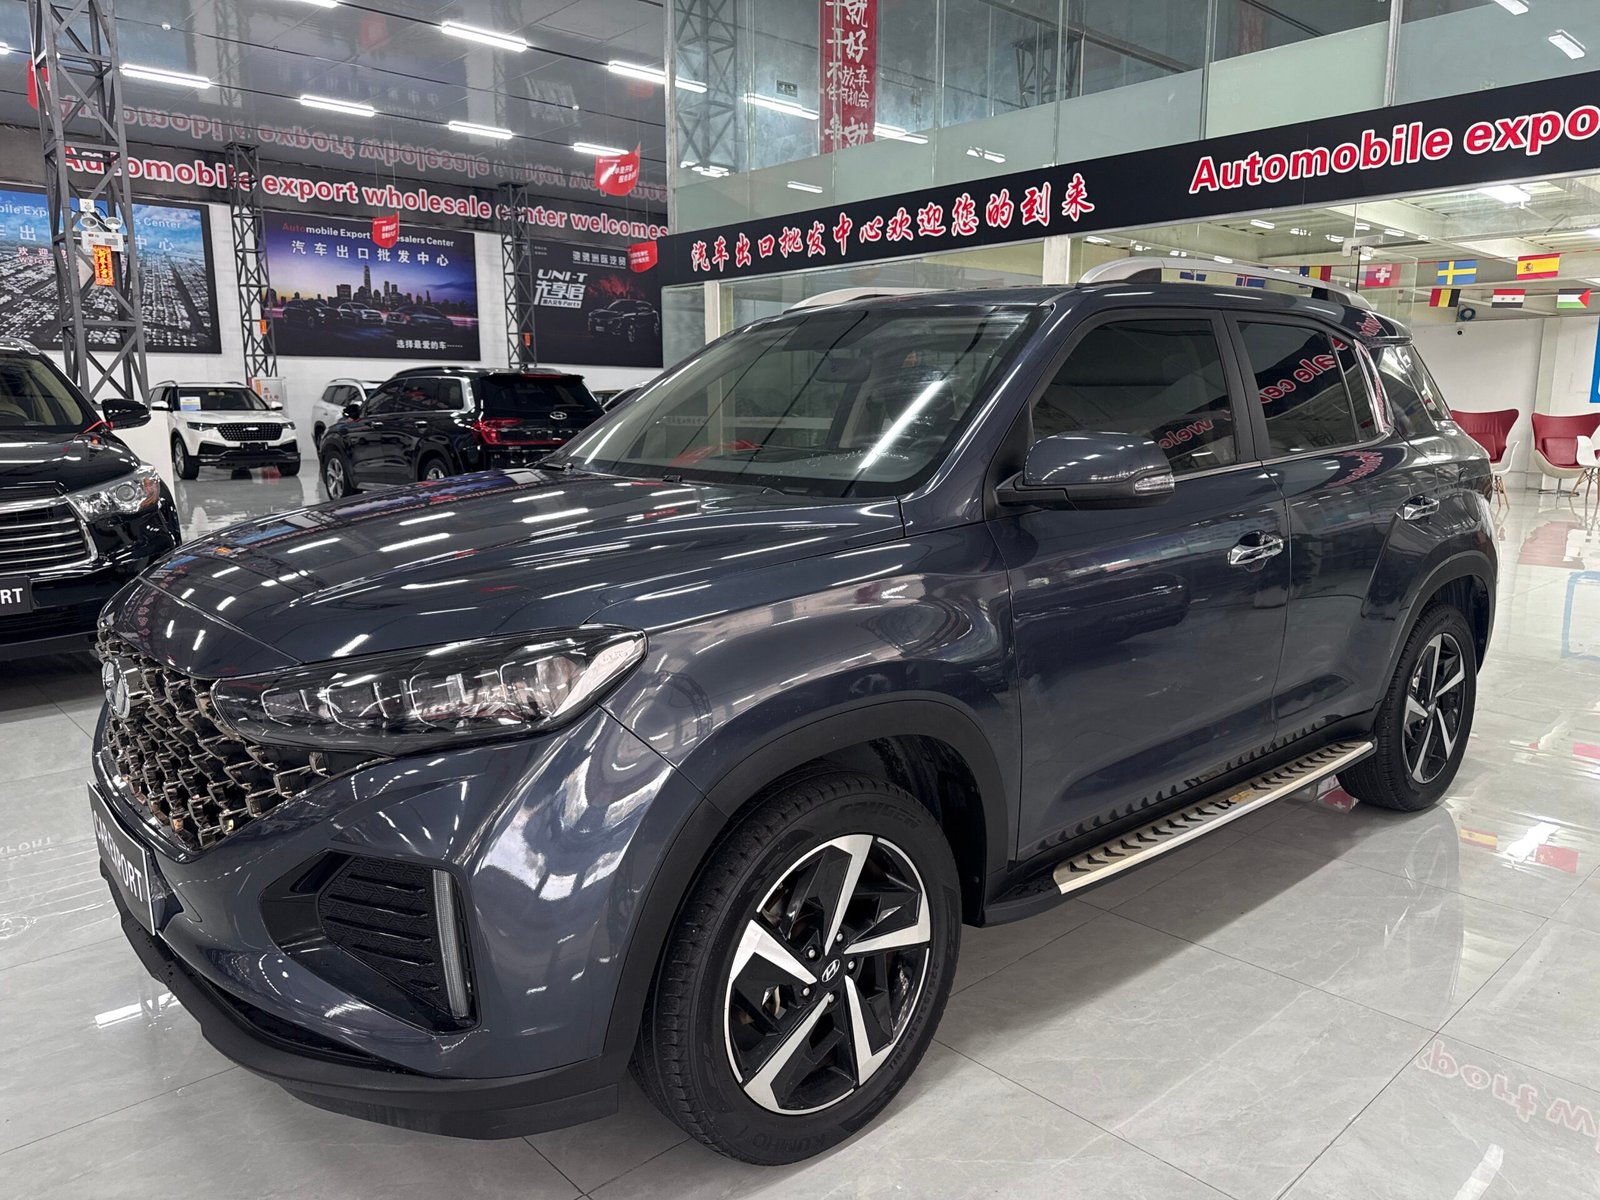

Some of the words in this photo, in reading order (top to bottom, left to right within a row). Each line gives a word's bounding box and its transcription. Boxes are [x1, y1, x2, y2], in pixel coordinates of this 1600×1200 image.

[1188, 121, 1452, 194] Automobile
[1463, 104, 1600, 156] expo
[263, 173, 358, 203] export
[361, 185, 491, 218] wholesale
[570, 213, 668, 240] welcomes
[143, 217, 181, 229] Center
[282, 222, 338, 236] Automobile
[340, 229, 371, 240] Export
[427, 236, 454, 248] Center
[691, 172, 1096, 273] 汽车出口批发中心欢迎您的到来
[291, 239, 449, 267] 汽车出口批发中心
[537, 269, 588, 283] UNI-T
